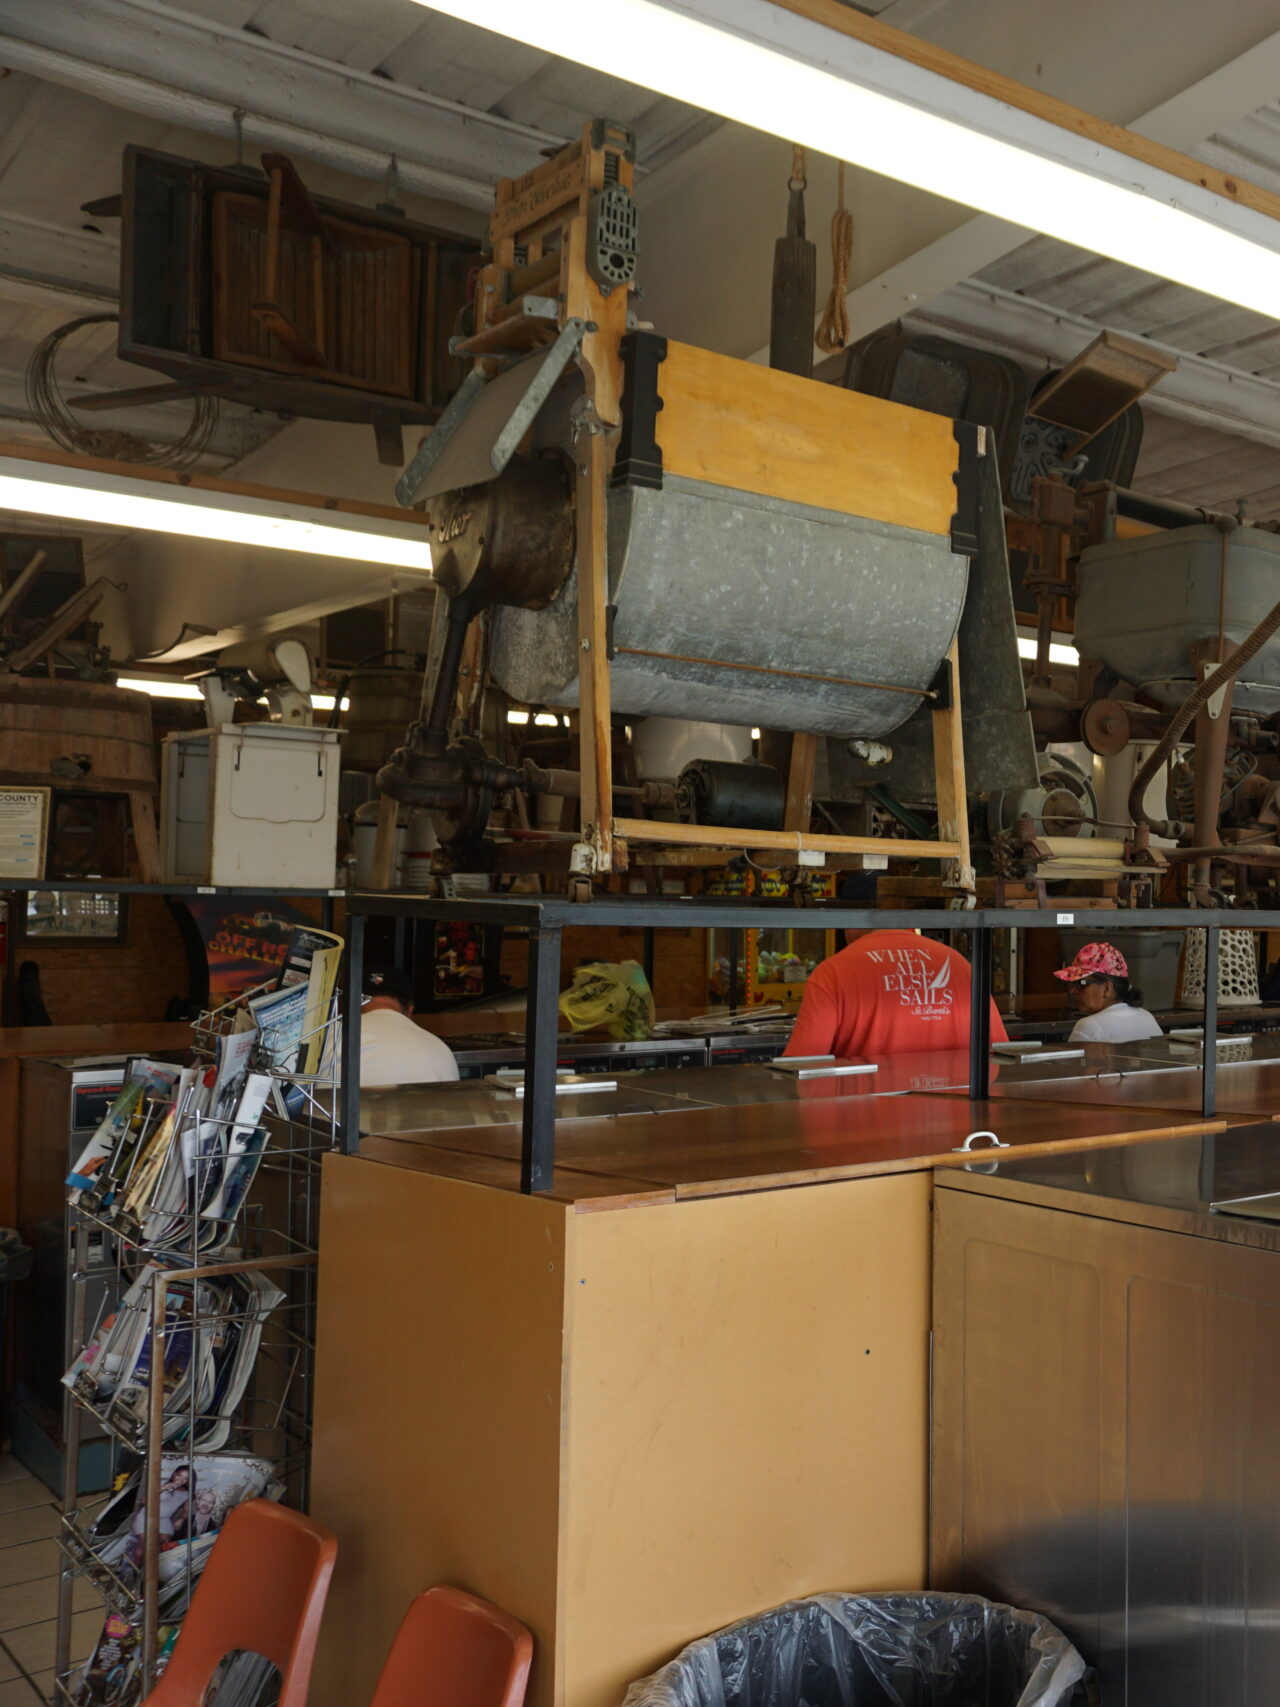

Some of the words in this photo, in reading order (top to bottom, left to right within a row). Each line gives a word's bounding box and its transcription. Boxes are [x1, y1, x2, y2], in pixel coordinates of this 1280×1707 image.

[215, 931, 257, 948] OFF
[208, 940, 285, 965] CHALLE
[866, 949, 932, 963] WHEN
[896, 960, 935, 976] ALL
[883, 975, 932, 991] ELSE
[900, 988, 953, 1006] SAILS
